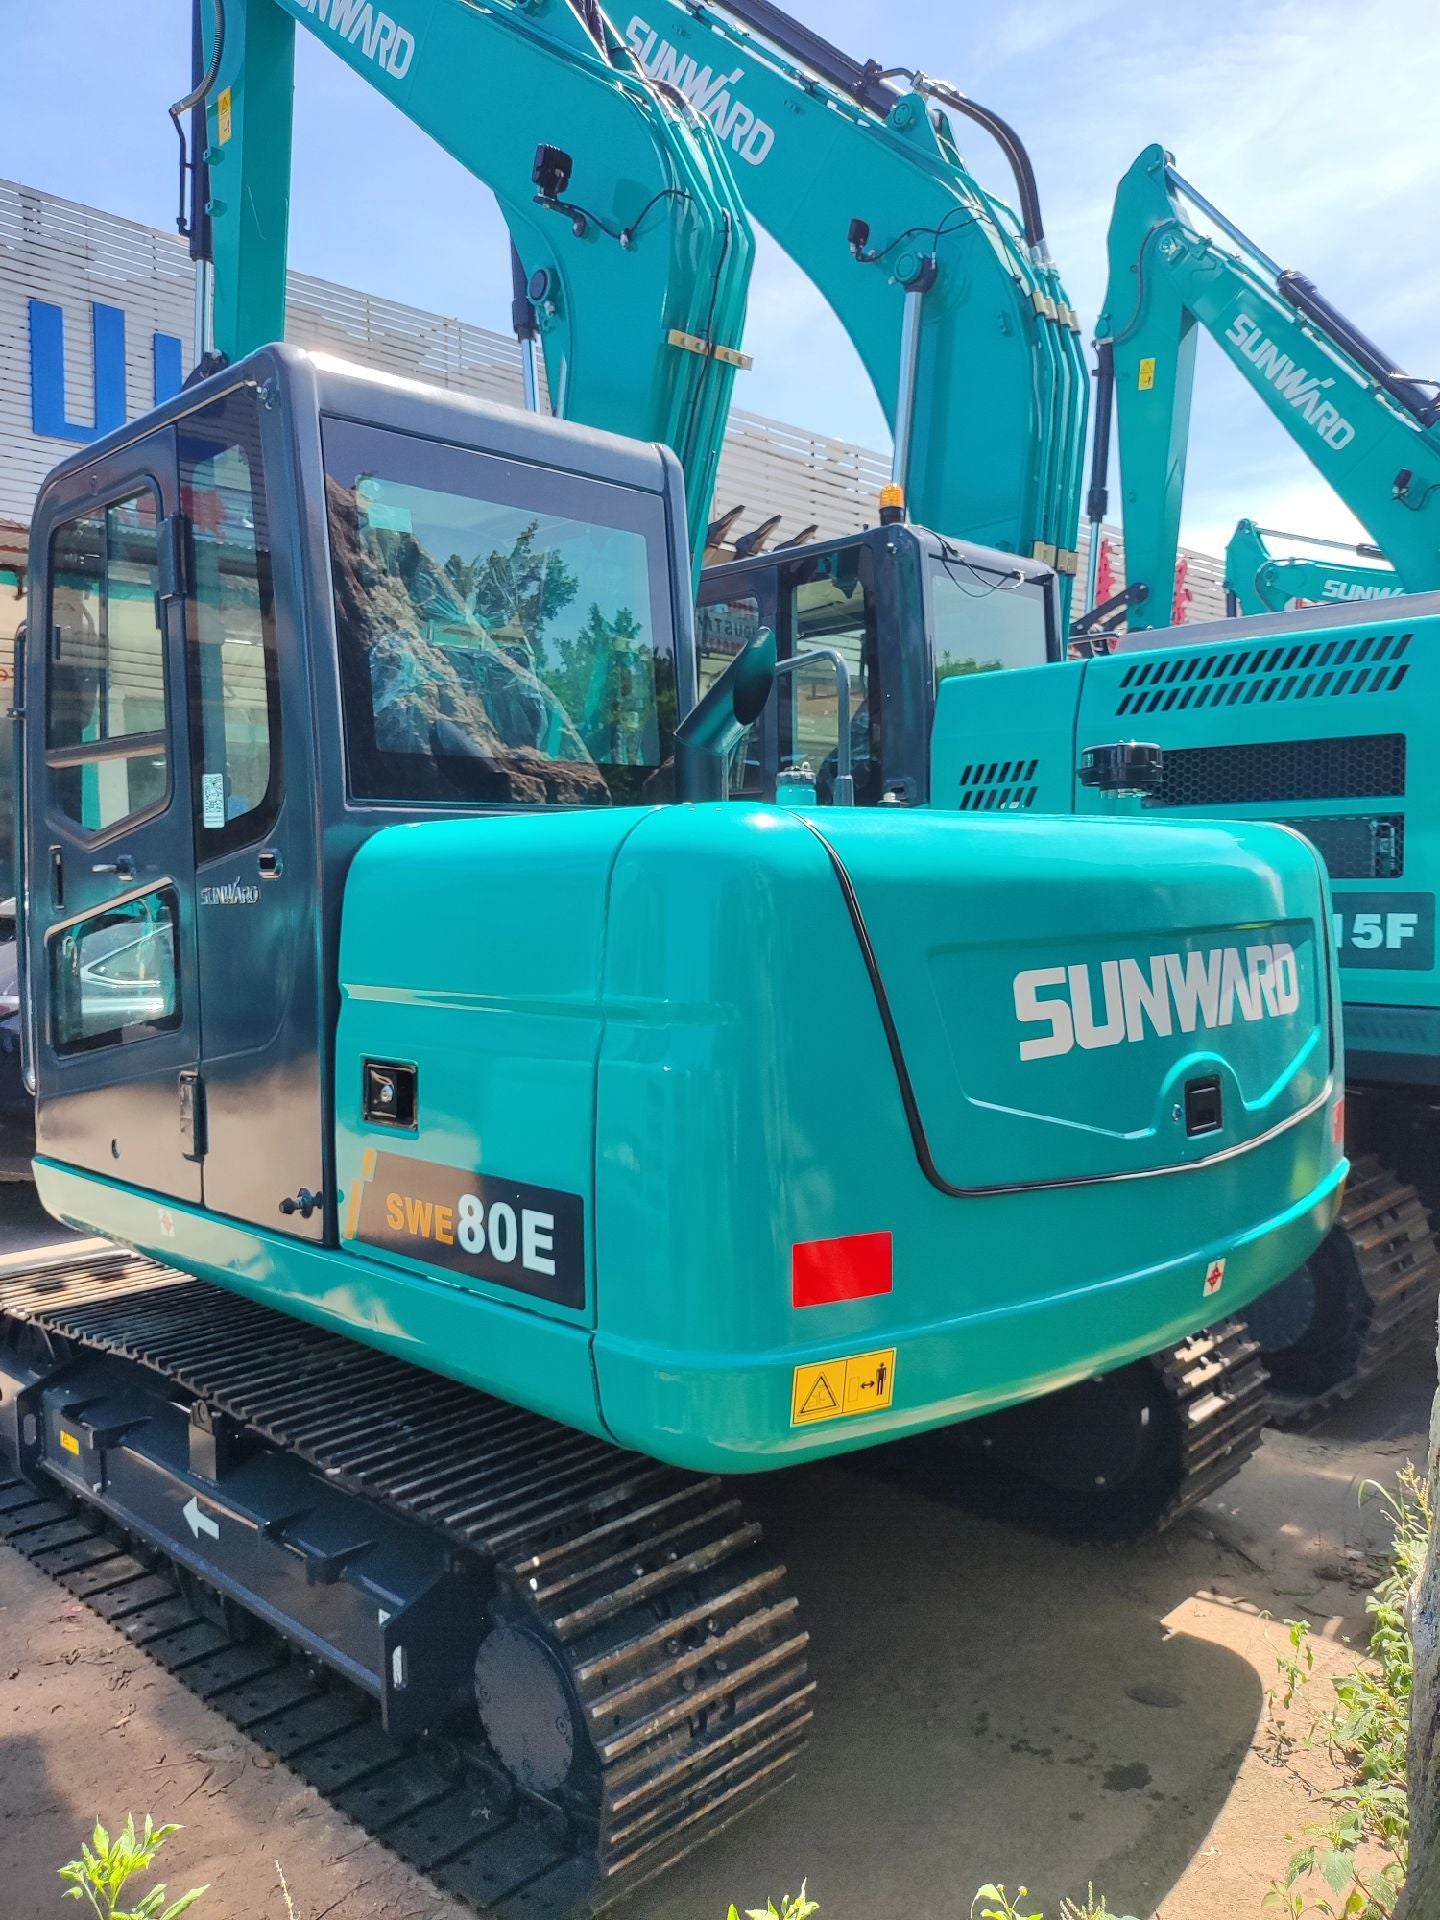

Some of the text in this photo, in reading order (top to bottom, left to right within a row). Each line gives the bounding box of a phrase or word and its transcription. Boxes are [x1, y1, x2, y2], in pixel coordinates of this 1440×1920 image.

[296, 0, 415, 80] WARD
[625, 15, 775, 166] SUNWARD
[1225, 313, 1356, 450] SUNWARD
[1321, 579, 1406, 601] SUNW
[200, 875, 259, 905] SUNWARD
[1013, 943, 1299, 1062] SUNWARD
[386, 1192, 556, 1276] SWE80E
